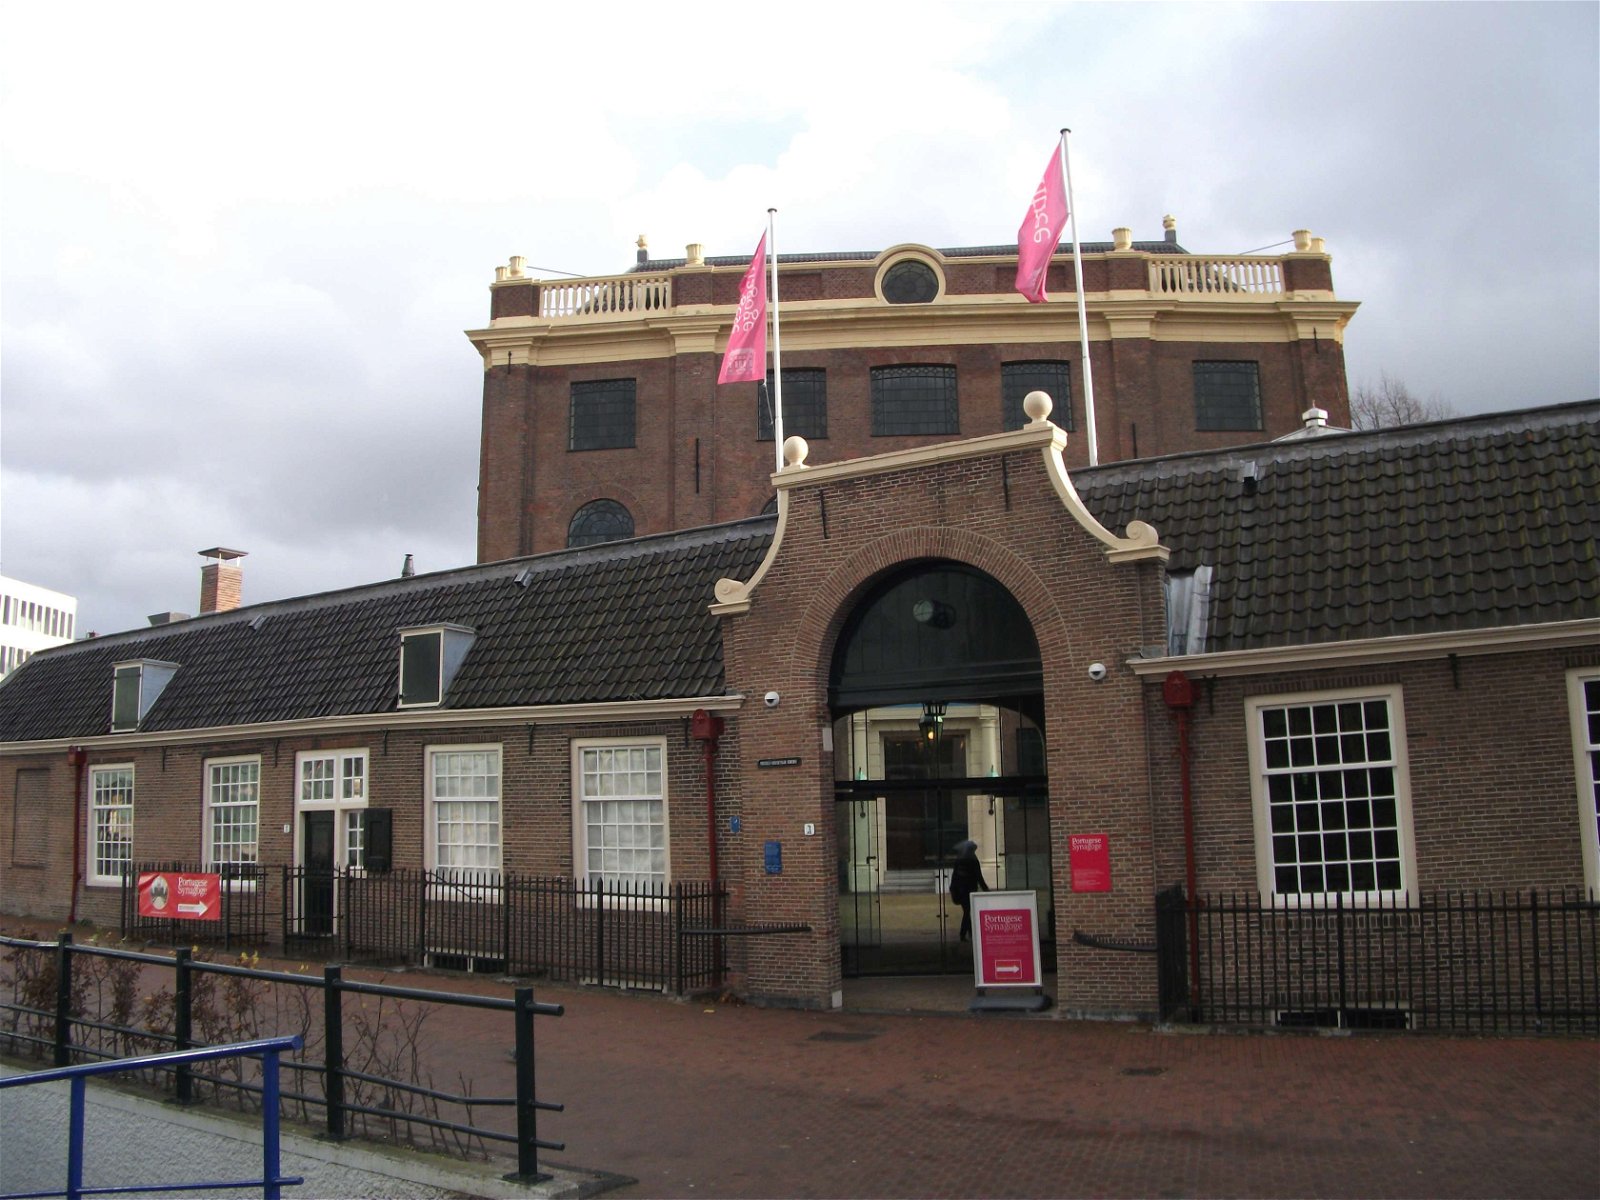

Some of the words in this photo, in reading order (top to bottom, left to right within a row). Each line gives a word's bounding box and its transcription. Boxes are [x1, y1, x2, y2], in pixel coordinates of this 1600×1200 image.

[178, 876, 208, 887] Portugese
[177, 885, 208, 897] Synagoge
[984, 914, 1023, 923] Portugese
[984, 922, 1023, 933] Synagoge
